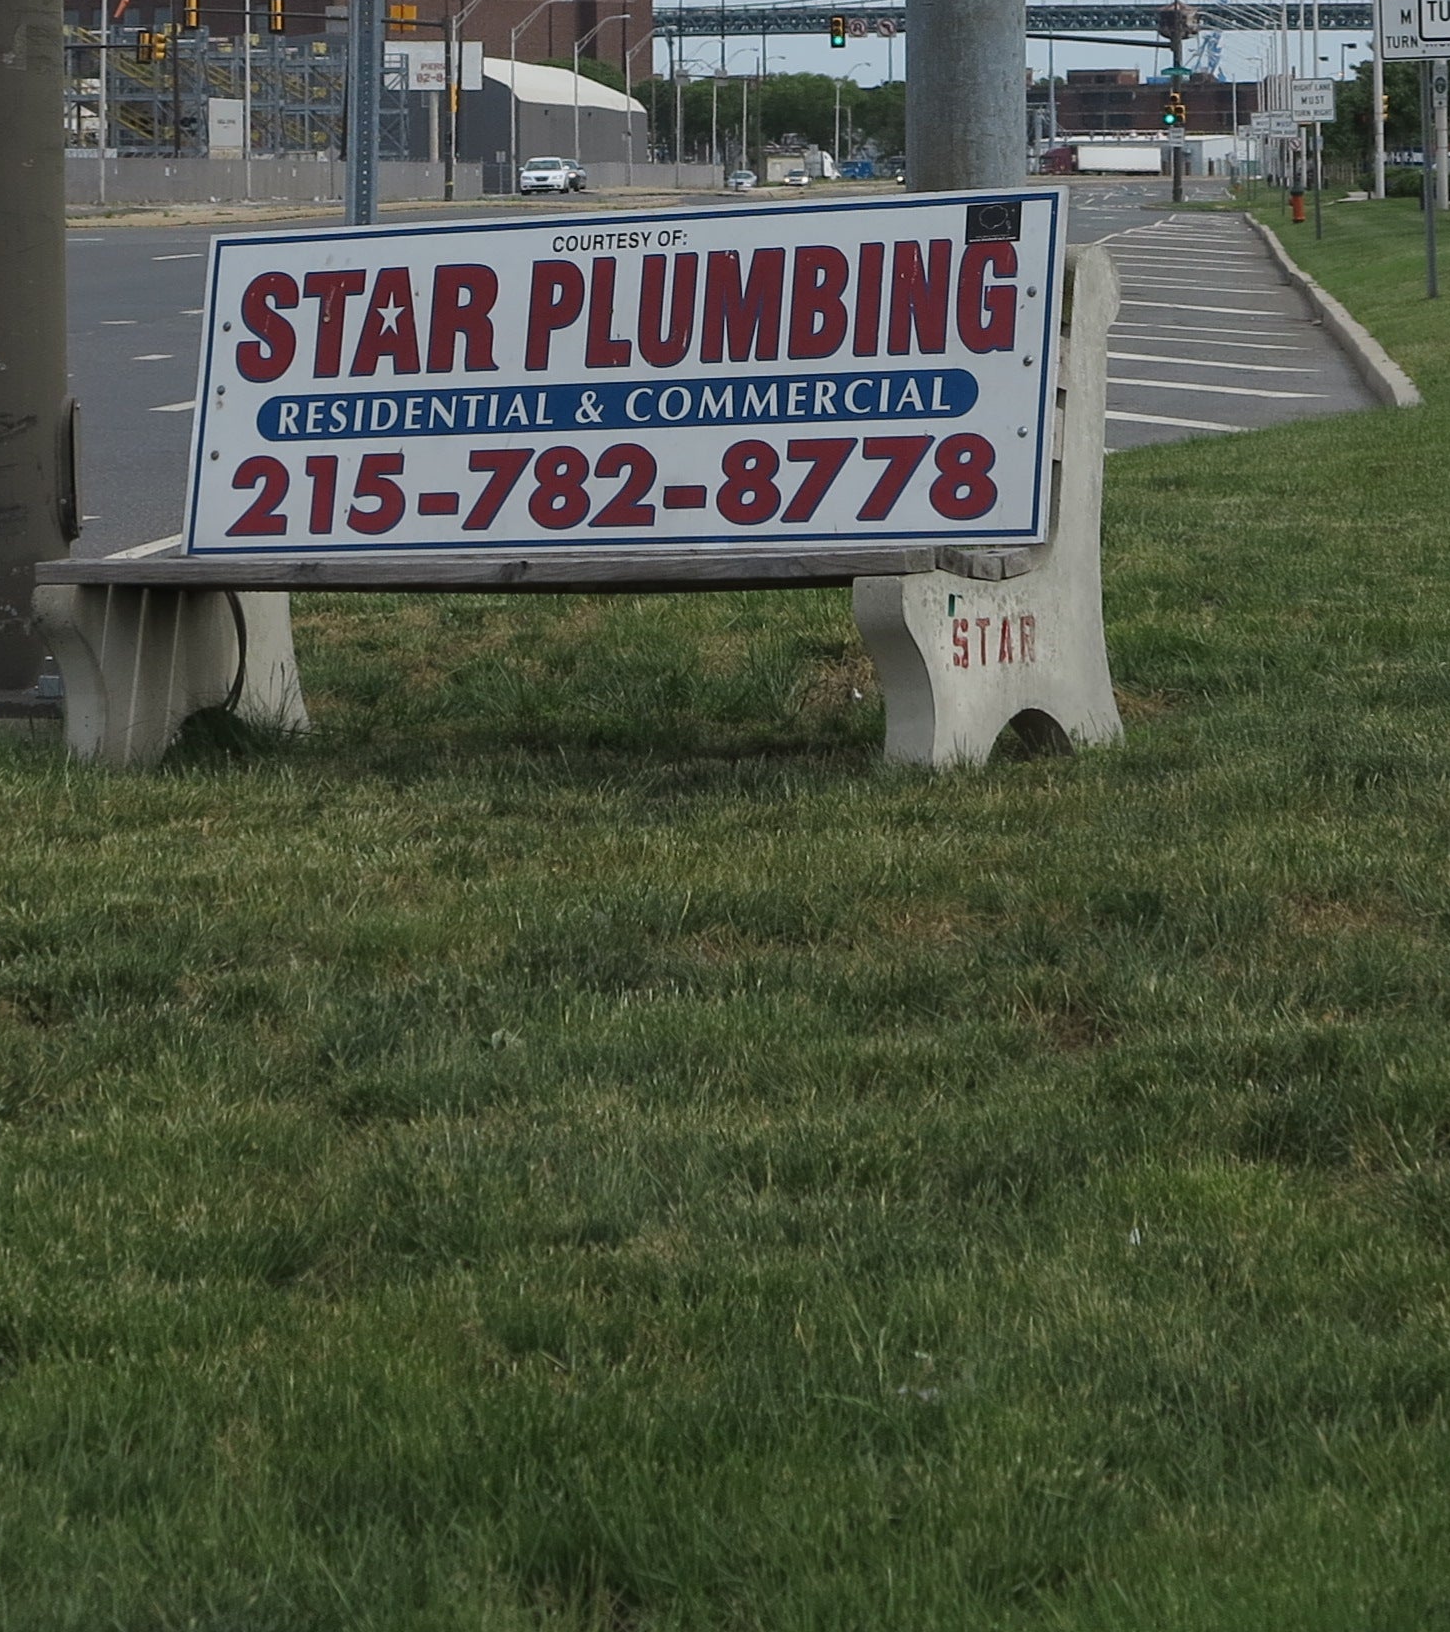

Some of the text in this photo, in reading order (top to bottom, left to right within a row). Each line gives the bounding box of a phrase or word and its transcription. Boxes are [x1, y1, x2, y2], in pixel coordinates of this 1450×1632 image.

[1385, 35, 1418, 49] TURN
[1301, 95, 1325, 105] MUST
[552, 229, 687, 253] COURTESY OF:
[235, 238, 1019, 383] STAR PLUMBING
[277, 376, 951, 436] RESIDENTIAL & COMMERCIAL
[224, 432, 998, 537] 215-782-8778
[952, 615, 1036, 669] STAR
